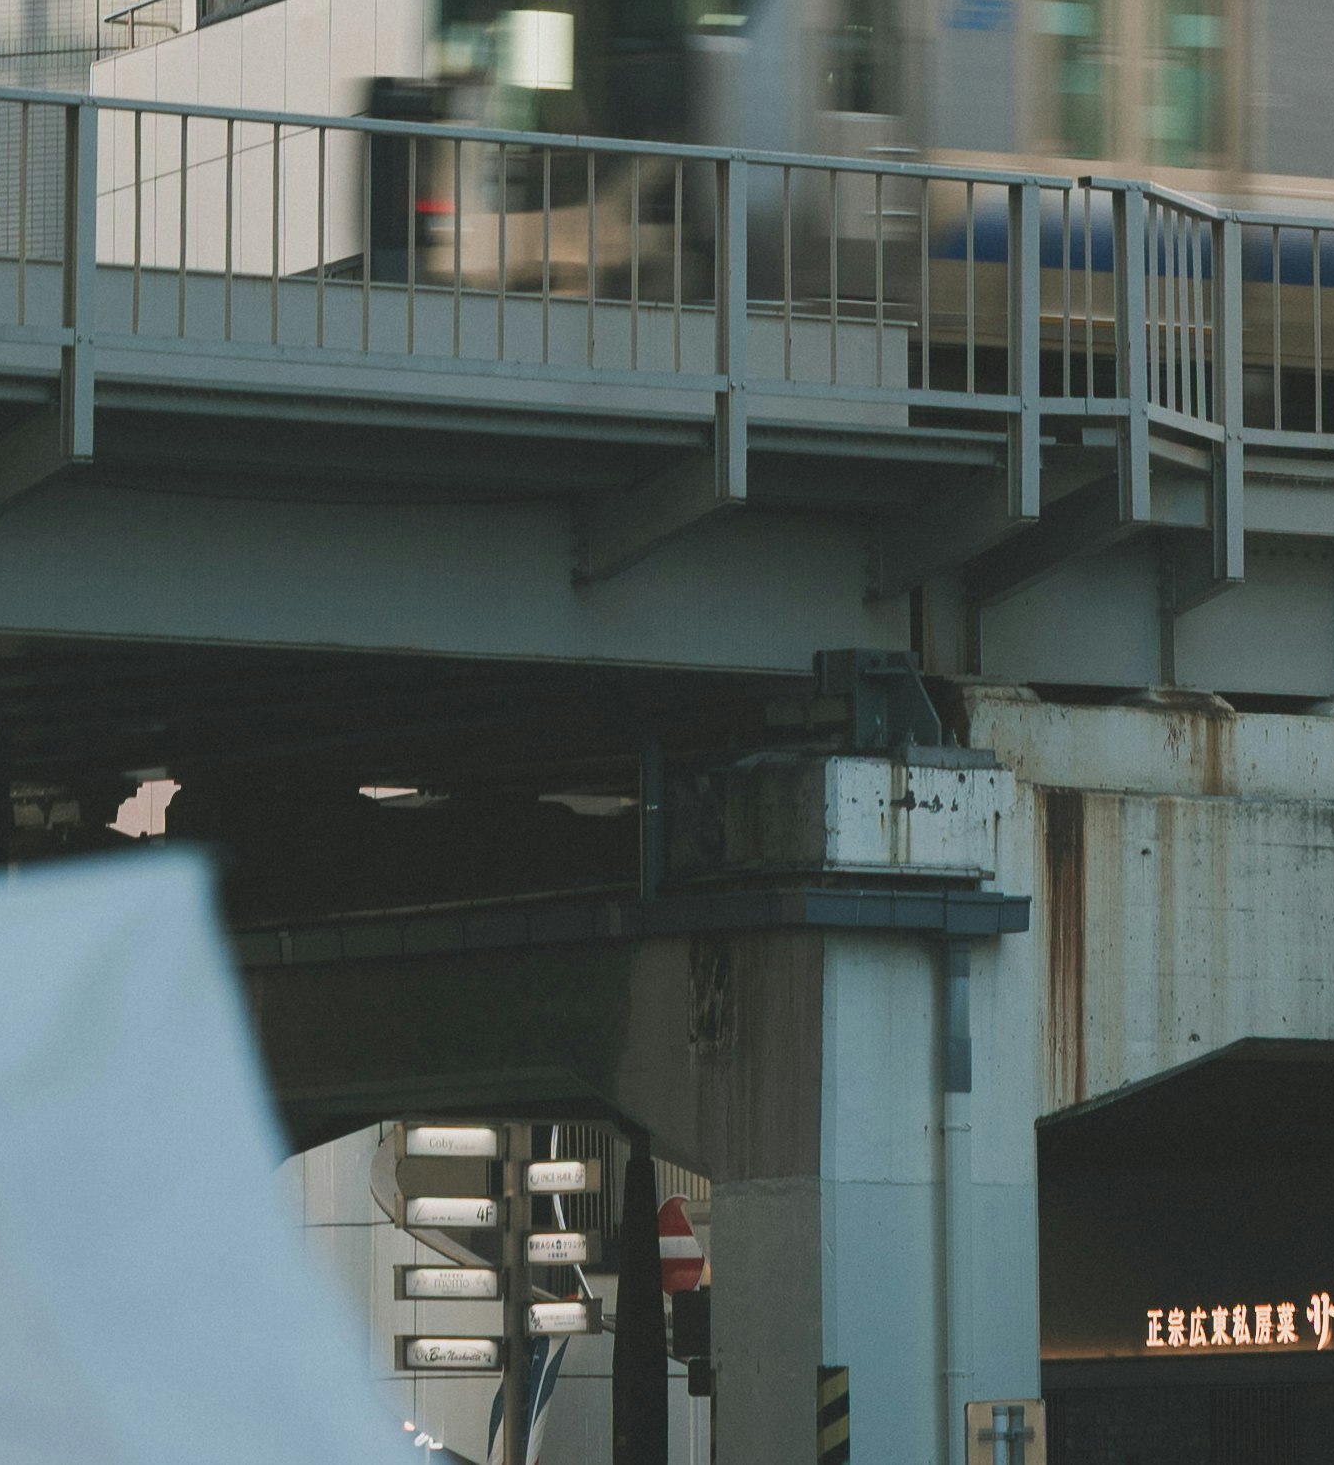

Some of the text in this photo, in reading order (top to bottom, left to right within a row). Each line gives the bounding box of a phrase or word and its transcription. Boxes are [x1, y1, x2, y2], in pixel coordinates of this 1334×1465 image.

[476, 1205, 494, 1222] 4F
[1146, 1302, 1299, 1348] 正宗広東私房菜
